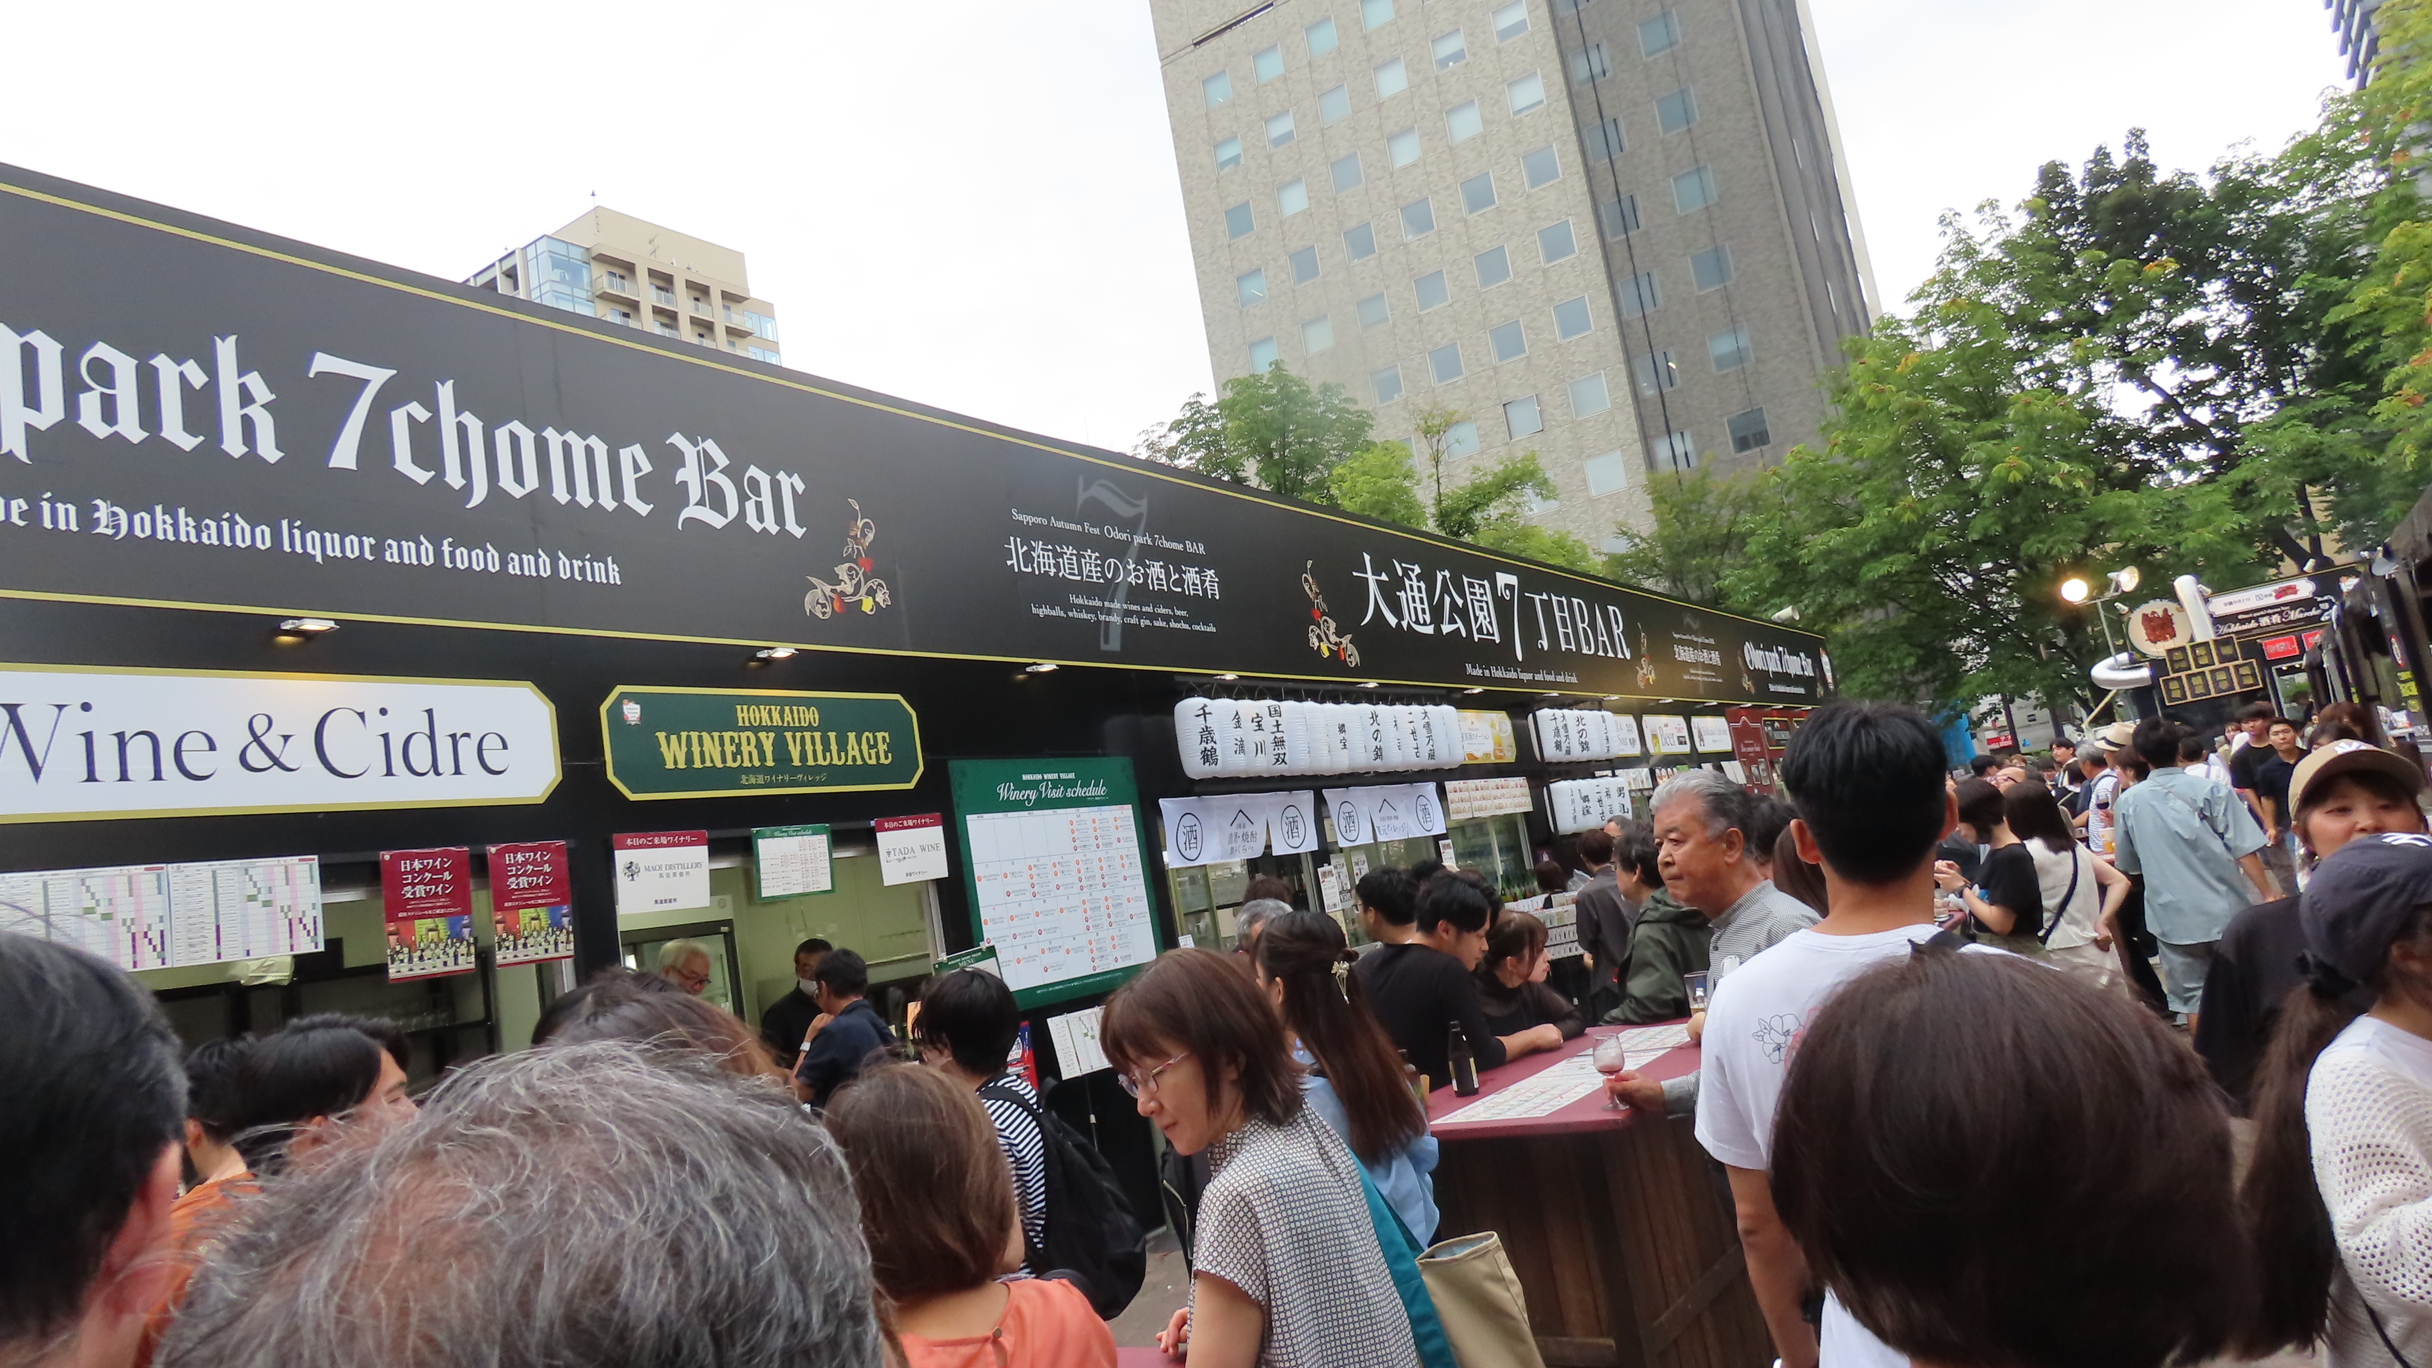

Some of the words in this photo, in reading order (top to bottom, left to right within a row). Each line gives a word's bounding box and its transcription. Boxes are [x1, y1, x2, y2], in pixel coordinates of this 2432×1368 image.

[307, 351, 655, 518] 7chome
[665, 431, 808, 539] Bar
[42, 491, 80, 533] in
[92, 497, 272, 551] Hokkaido
[280, 517, 376, 565] liquor
[384, 534, 435, 567] and
[441, 541, 501, 574] food
[507, 547, 551, 579] and
[557, 552, 623, 587] drink
[1011, 508, 1048, 527] Sapporo
[1050, 516, 1083, 533] Autumn
[1084, 522, 1100, 535] Fest
[1104, 525, 1131, 543] Odori
[1132, 533, 1153, 548] park
[1154, 534, 1184, 552] 7chome
[1185, 540, 1207, 556] BAR
[1003, 535, 1220, 601] 北海道産のお酒と酒肴
[1069, 594, 1102, 607] Hokkaido
[1104, 599, 1121, 610] made
[1122, 601, 1141, 612] wines
[1142, 603, 1153, 613] and
[1352, 551, 1632, 662] 大通公園7丁目BAR
[1031, 603, 1066, 618] highballs,
[1068, 609, 1097, 623] whiskey,
[1123, 614, 1139, 625] craft
[1192, 621, 1217, 633] cocktails
[1465, 663, 1483, 677] Made
[1483, 666, 1490, 677] in
[1490, 666, 1518, 679] Hokkaido
[1534, 670, 1544, 681] and
[1556, 672, 1565, 682] and
[735, 704, 820, 728] HOKKAIDO
[239, 712, 301, 772] &
[313, 706, 510, 779] Cidre
[1194, 703, 1219, 767] 千歳鶴
[1231, 710, 1246, 756] 金滴
[1251, 712, 1267, 758] 宝川
[1368, 710, 1383, 762] 北の錦
[1575, 714, 1590, 753] 北の錦
[1658, 726, 1676, 747] Beer
[655, 731, 776, 770] WINERY
[784, 731, 894, 766] VILLAGE
[739, 772, 827, 785] 北海道ワイナリーヴィレッジ
[996, 782, 1039, 806] Winery
[1038, 781, 1065, 799] Visit
[1066, 779, 1107, 797] schedule
[884, 817, 935, 829] 本日のご来場ワイナリー
[1342, 809, 1357, 834] 酒
[1418, 802, 1432, 824] 酒
[1182, 823, 1198, 851] 酒
[1285, 814, 1300, 840] 酒
[625, 835, 698, 847] 本日のご来場ワイナリー
[892, 846, 915, 857] TADA
[919, 843, 941, 853] WINE
[400, 857, 453, 872] 日本ワイン
[505, 850, 552, 865] 日本ワイン
[506, 864, 553, 876] コンクール
[664, 861, 703, 872] DISTILLERY
[402, 871, 454, 884] コンクール
[506, 875, 554, 890] 受賞ワイン
[401, 883, 454, 900] 受賞ワイン
